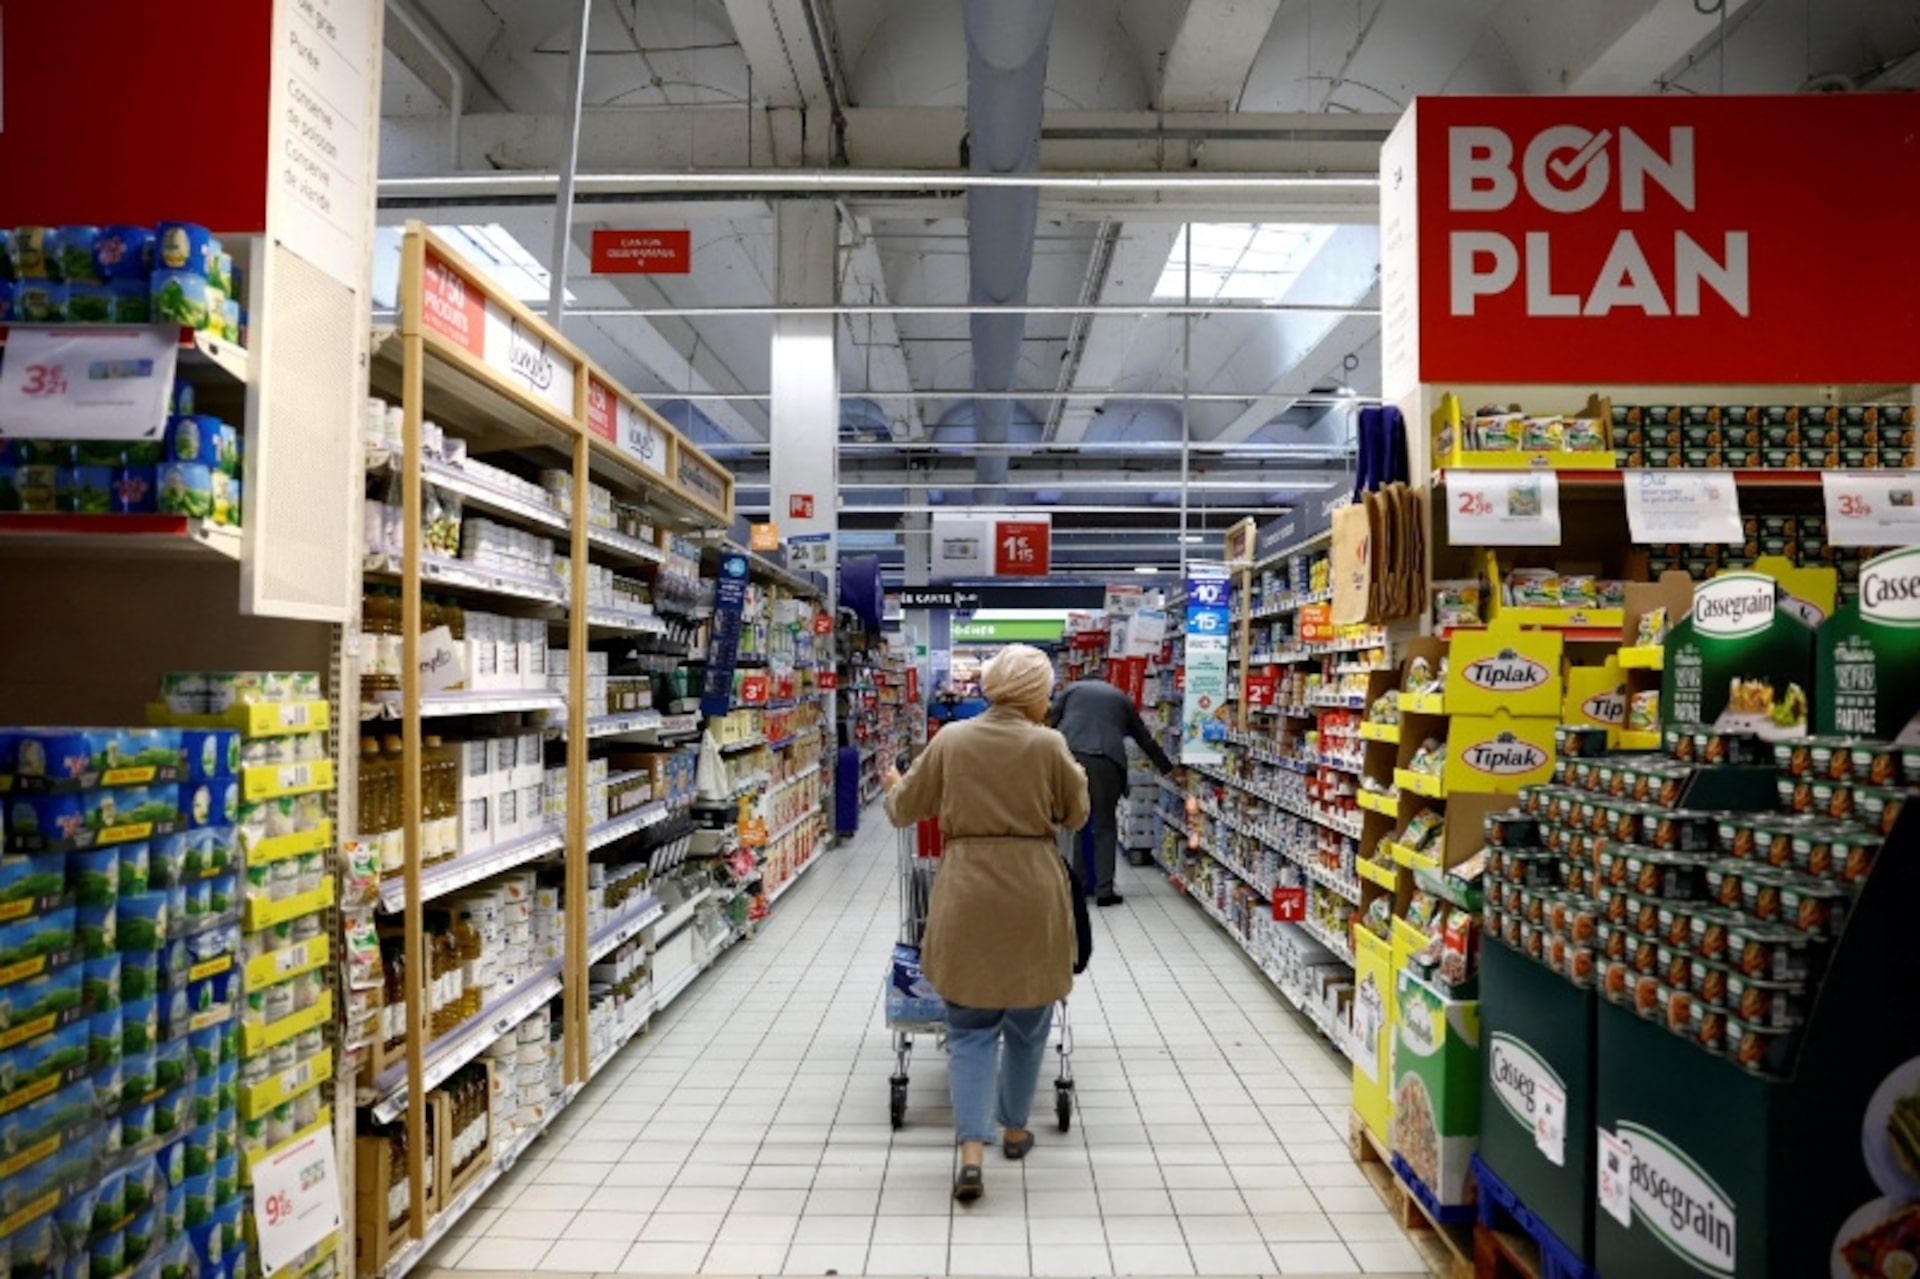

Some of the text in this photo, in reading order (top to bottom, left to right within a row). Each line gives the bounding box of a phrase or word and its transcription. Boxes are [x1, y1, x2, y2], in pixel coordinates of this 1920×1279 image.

[287, 78, 333, 130] Conserve
[285, 139, 331, 188] Conserve
[1448, 124, 1696, 213] BON
[1449, 229, 1750, 317] PLAN
[951, 624, 996, 637] OCHER
[1695, 588, 1773, 625] Cassegrain
[1593, 699, 1624, 720] Tip
[1493, 1046, 1536, 1113] Casseg
[1620, 1138, 1732, 1258] assegrain
